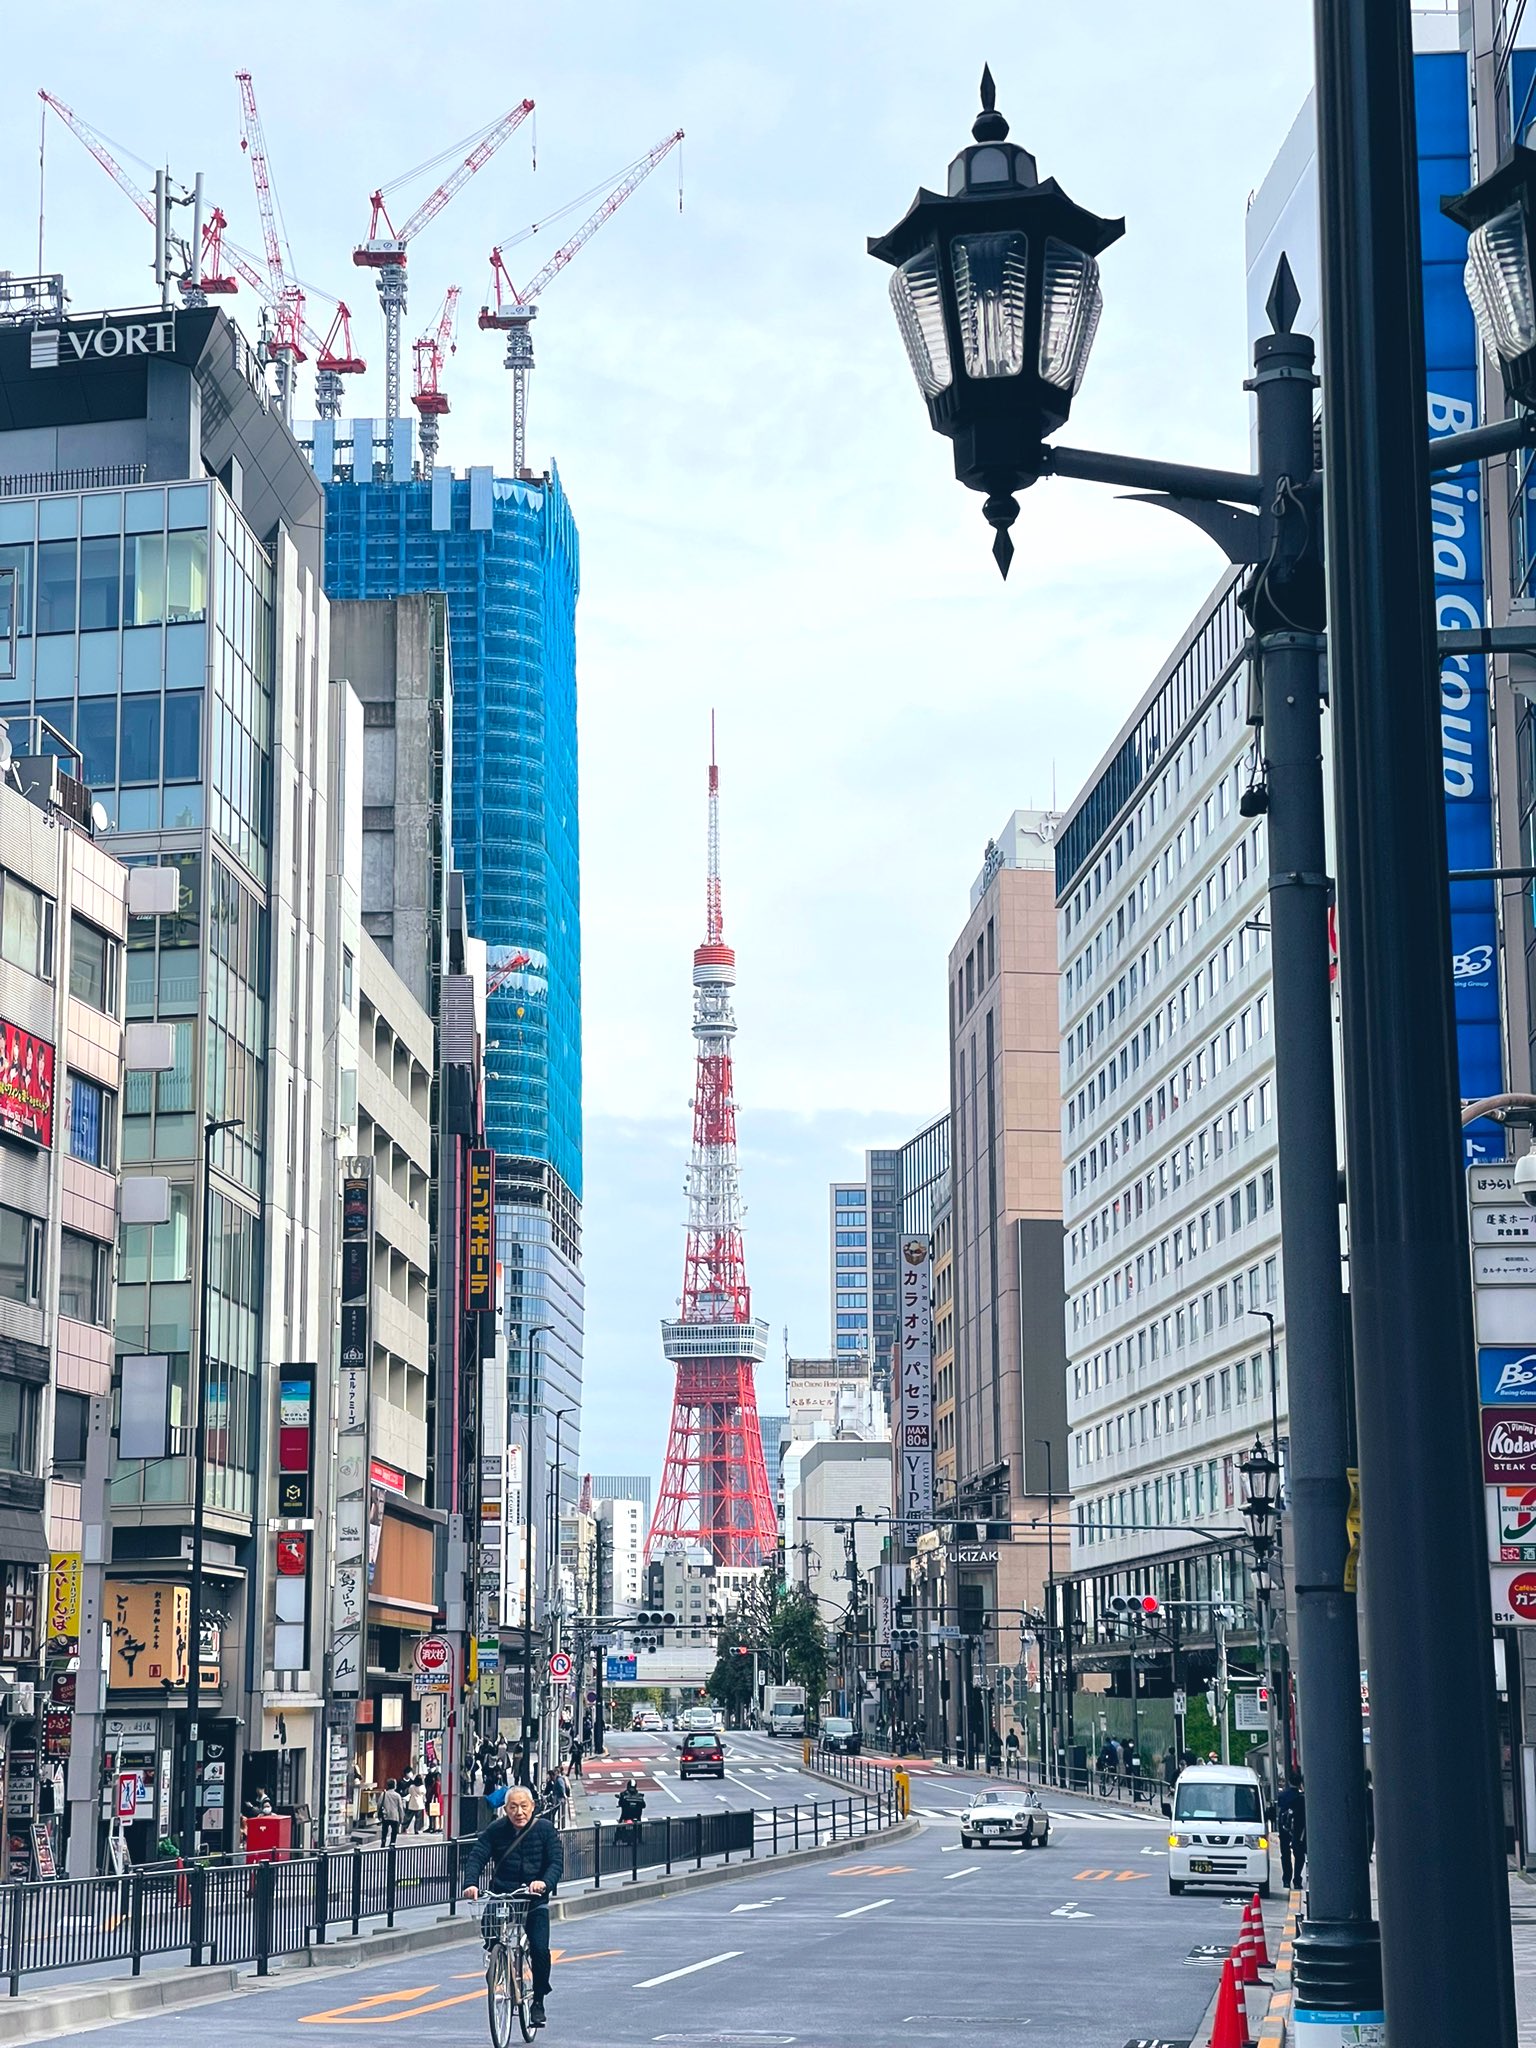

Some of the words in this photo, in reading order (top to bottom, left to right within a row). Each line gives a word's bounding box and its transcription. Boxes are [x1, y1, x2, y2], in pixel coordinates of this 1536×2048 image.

[68, 322, 174, 360] VORT
[903, 1270, 920, 1350] カラオケ
[921, 1273, 929, 1346] KARAOKE
[904, 1361, 921, 1421] パセラ
[922, 1364, 930, 1418] PASELA
[907, 1426, 927, 1435] MAX
[907, 1436, 928, 1446] 80名
[1494, 1463, 1526, 1471] STEAK
[945, 1551, 1002, 1562] YUKIZAKI
[52, 1559, 69, 1631] くいしんぼ
[1494, 1612, 1515, 1621] B1F
[421, 1648, 445, 1660] 消火栓
